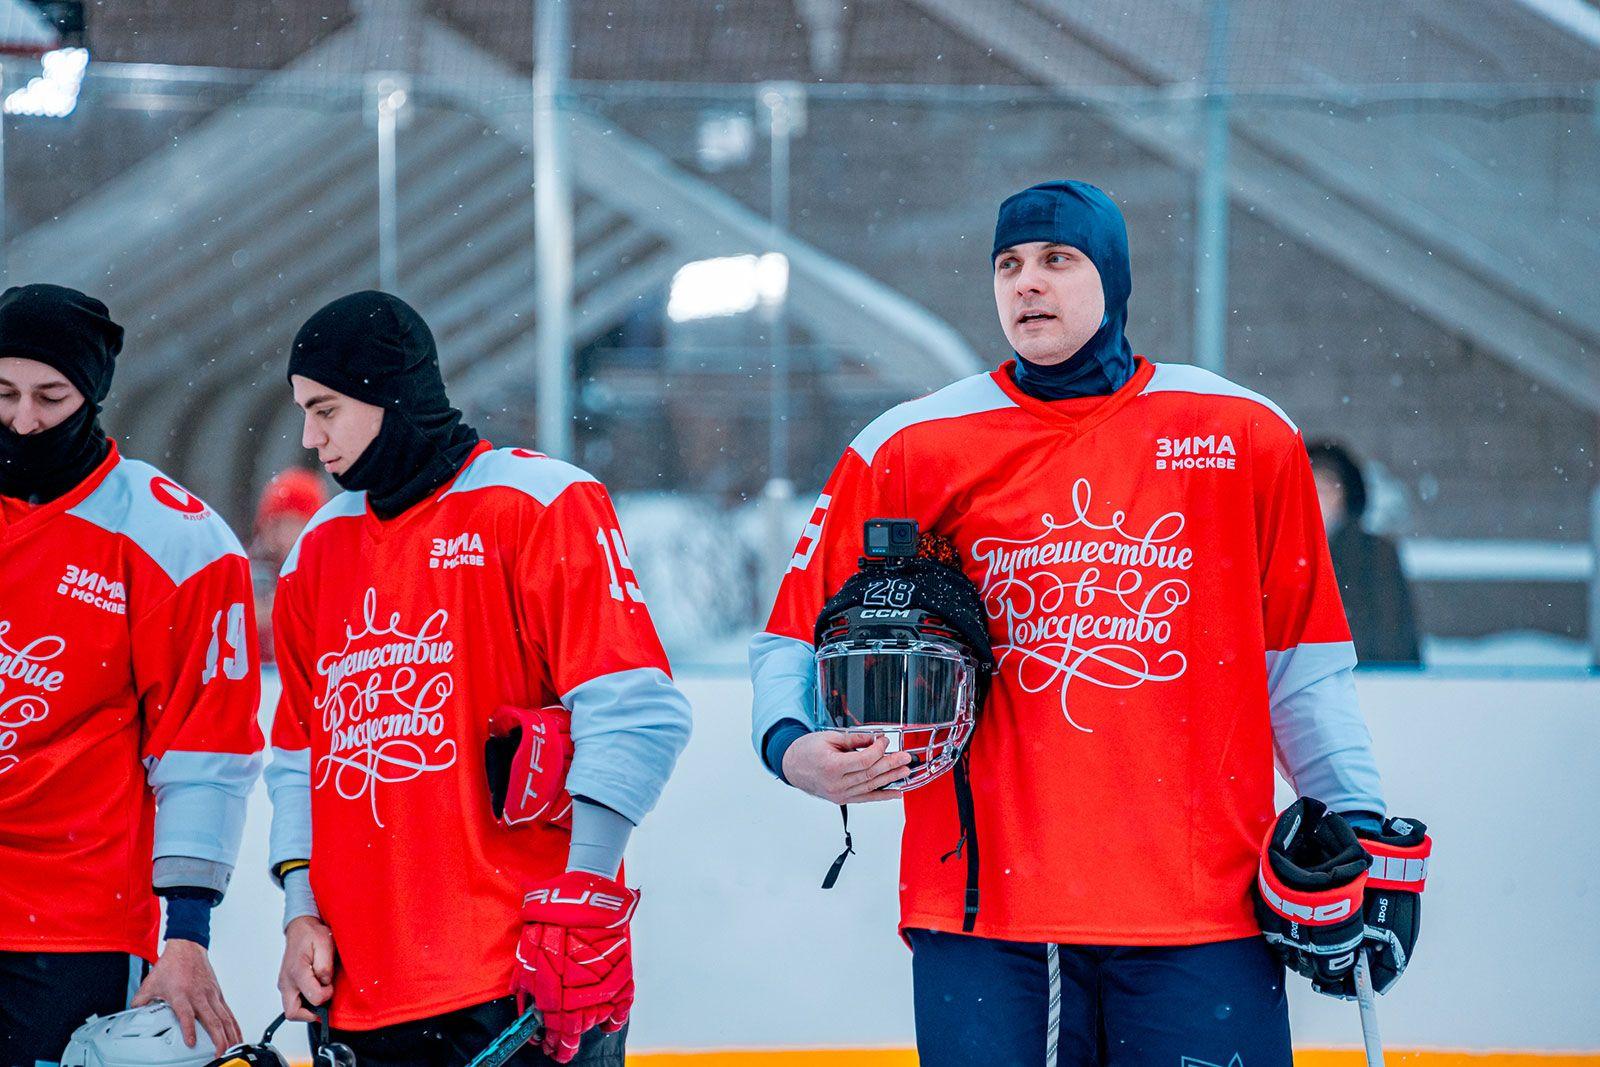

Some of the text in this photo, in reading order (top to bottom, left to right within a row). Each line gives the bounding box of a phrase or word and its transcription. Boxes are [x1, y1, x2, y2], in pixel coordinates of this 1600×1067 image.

[1156, 435, 1236, 457] ЗИМА
[1156, 456, 1236, 470] В МОСКВЕ
[430, 532, 484, 556] ЗИМА
[971, 511, 1193, 592] Путешествие
[443, 554, 485, 569] МКВЕ
[61, 564, 126, 601] ЗИМА
[863, 578, 915, 608] 28
[57, 583, 126, 614] В МОСКВЕ
[860, 609, 911, 618] CCM
[202, 602, 248, 684] 19
[317, 608, 453, 692] Пешествие
[522, 888, 624, 911] RUE
[1378, 898, 1388, 923] goat
